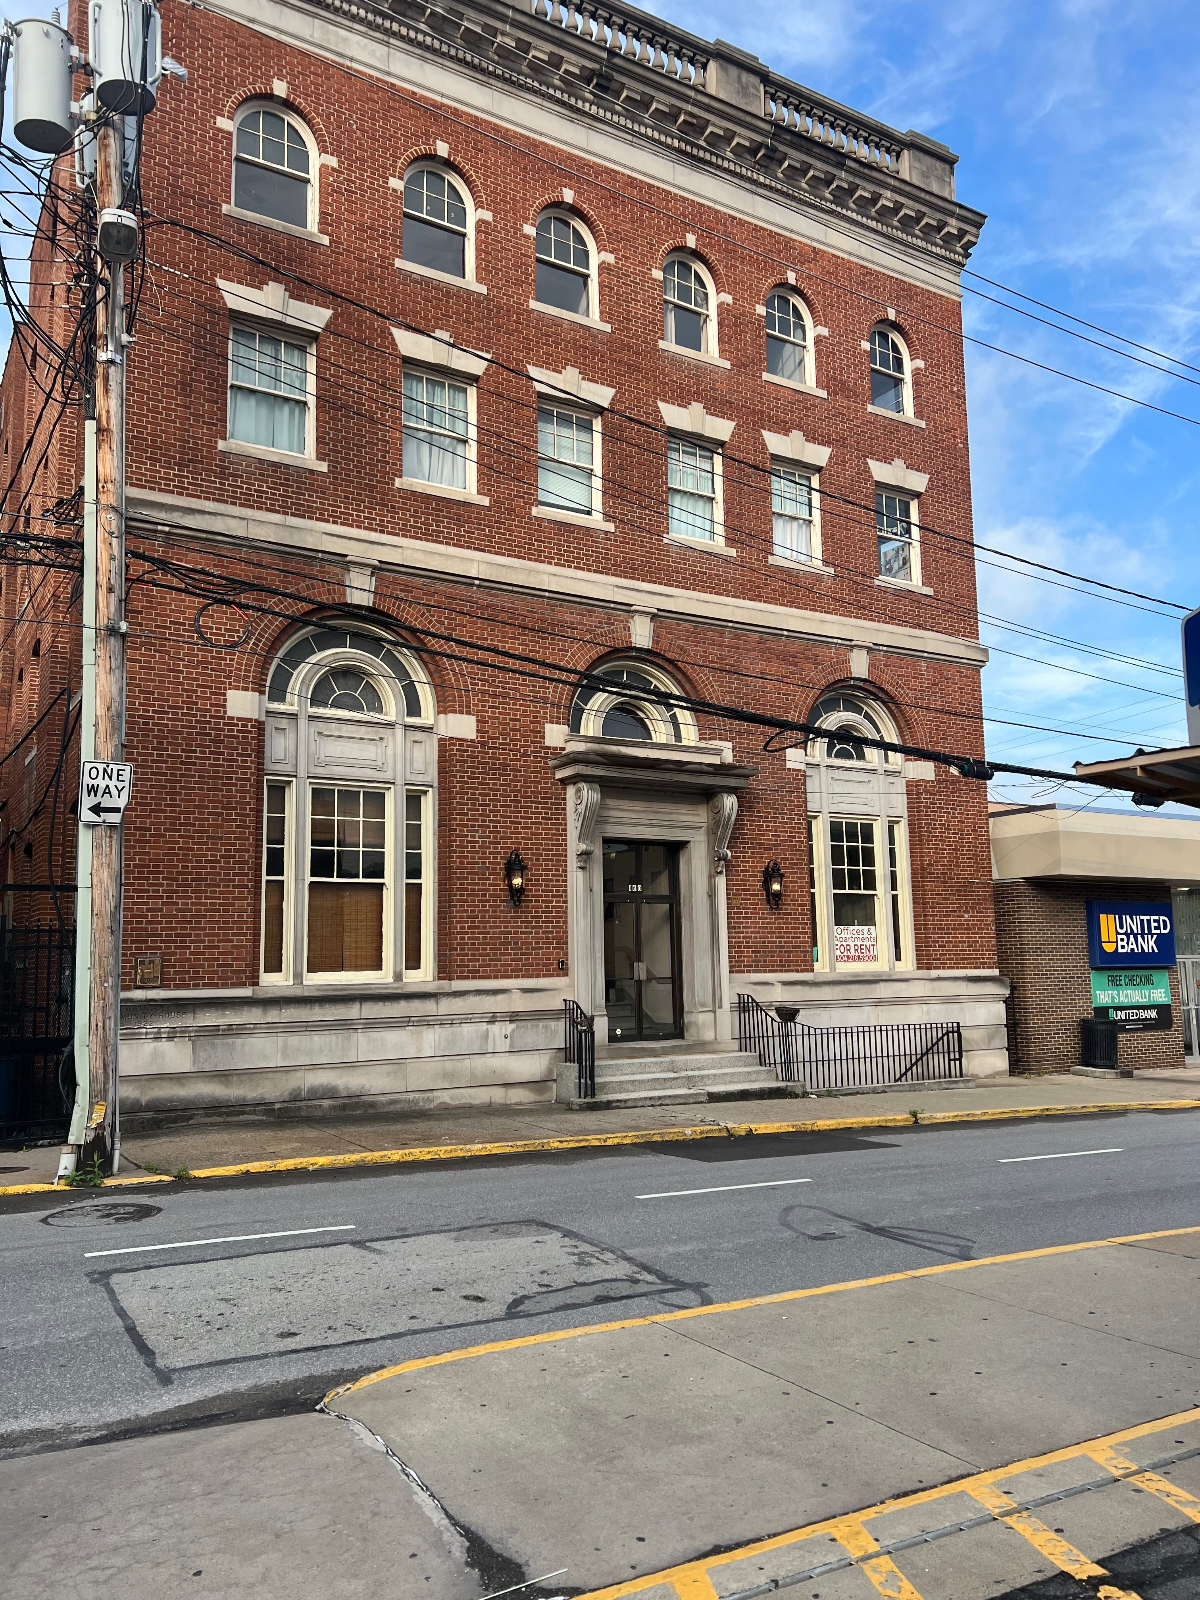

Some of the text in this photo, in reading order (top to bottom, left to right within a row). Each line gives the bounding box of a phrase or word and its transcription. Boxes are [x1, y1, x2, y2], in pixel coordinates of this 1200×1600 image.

[89, 766, 126, 782] ONE
[86, 783, 126, 799] WAY
[836, 926, 872, 935] Offices &
[1115, 915, 1171, 934] UNITED
[835, 944, 876, 954] FOR RENT
[1116, 934, 1159, 953] BANK
[1107, 973, 1155, 987] FREE CHECKING
[1095, 988, 1168, 1004] THAT'S ACTUALLY FREE.
[1113, 1008, 1158, 1020] UNITED BANK
